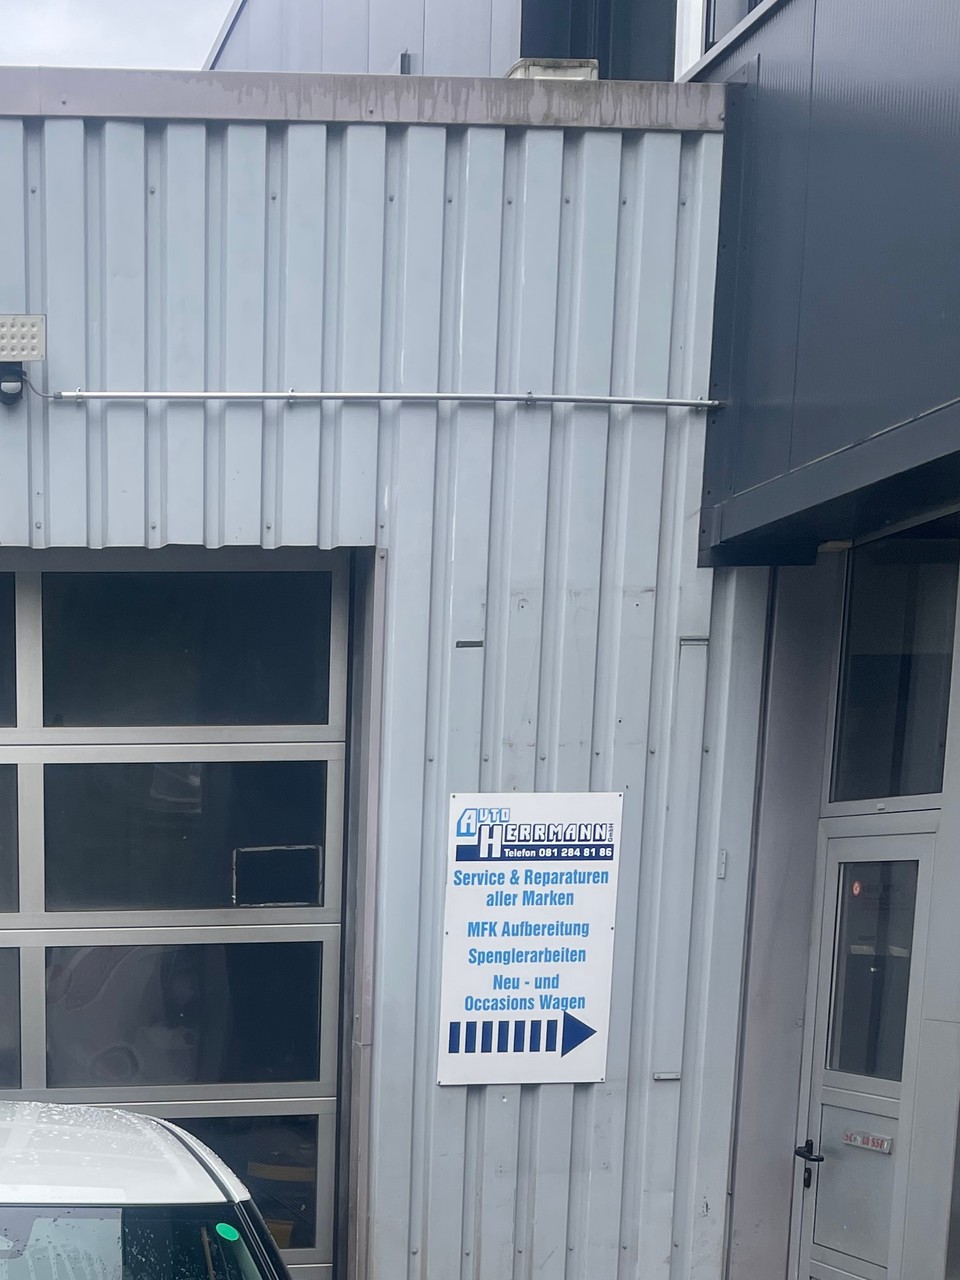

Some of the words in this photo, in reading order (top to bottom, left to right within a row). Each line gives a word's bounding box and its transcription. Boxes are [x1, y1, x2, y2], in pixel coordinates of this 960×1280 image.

[456, 808, 510, 837] AUTO
[478, 823, 608, 858] HERRMANN
[504, 848, 536, 857] Telefon
[538, 848, 558, 857] 081
[561, 848, 581, 857] 284
[584, 848, 598, 857] 81
[599, 847, 613, 857] 86
[453, 870, 505, 886] Service
[509, 869, 520, 885] &
[524, 869, 609, 887] Reparaturen
[486, 891, 518, 906] aller
[522, 890, 574, 906] Marken
[467, 921, 497, 937] MFK
[501, 921, 590, 938] Aufbereitung
[468, 947, 586, 965] Spenglerarbeiten
[493, 974, 520, 990] Neu
[534, 974, 560, 989] und
[464, 995, 535, 1011] Occasions
[539, 994, 586, 1011] Wagen
